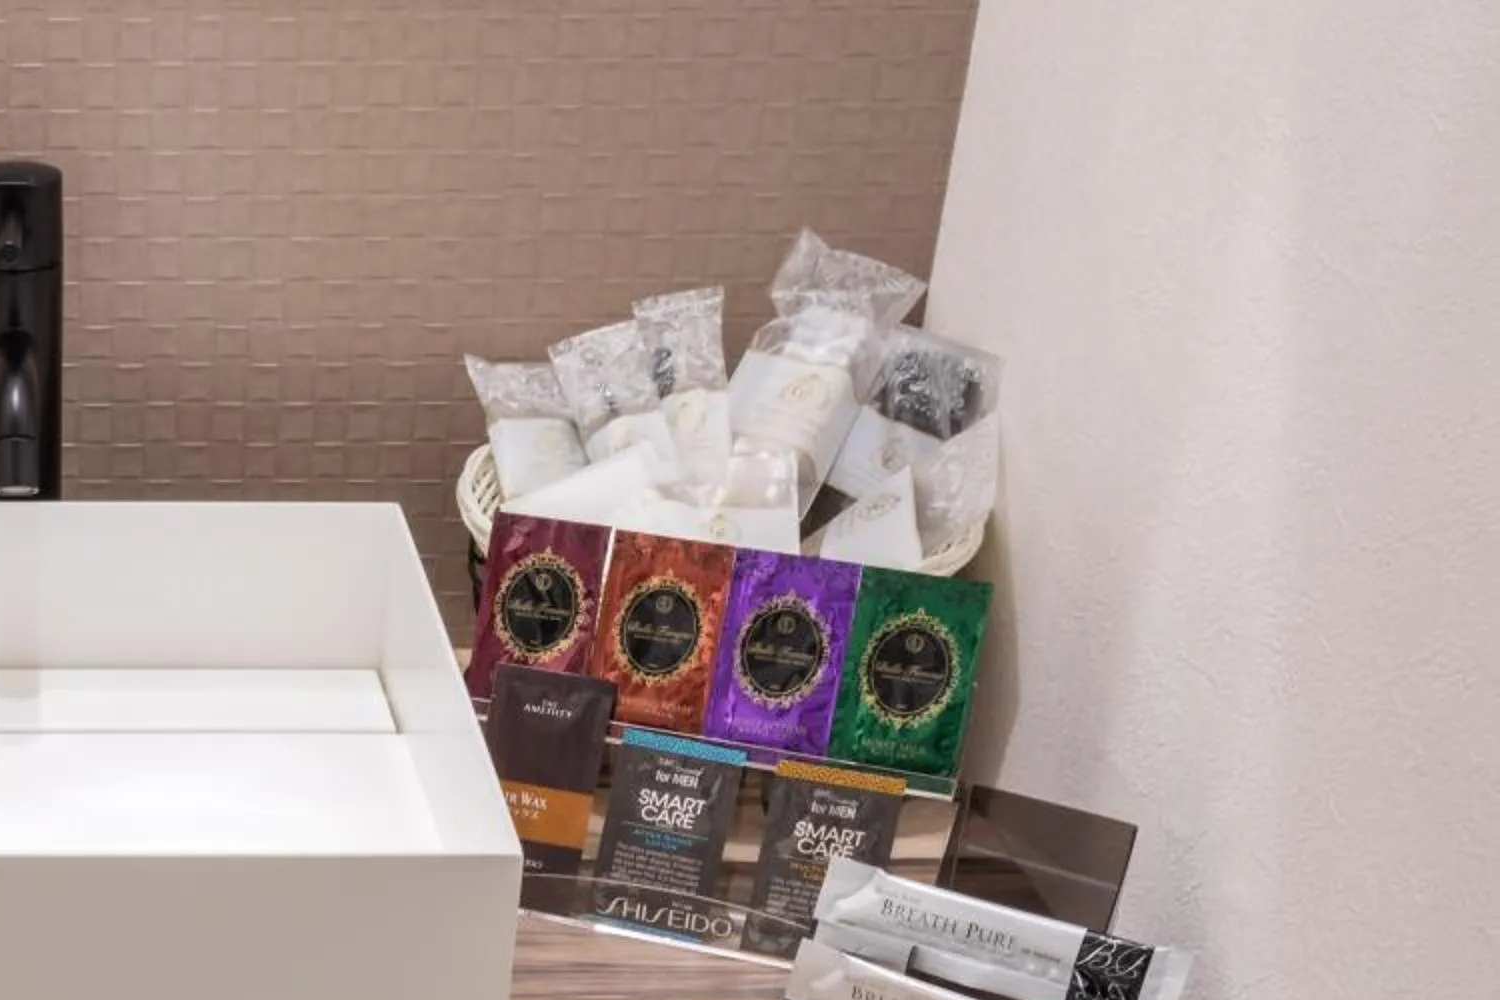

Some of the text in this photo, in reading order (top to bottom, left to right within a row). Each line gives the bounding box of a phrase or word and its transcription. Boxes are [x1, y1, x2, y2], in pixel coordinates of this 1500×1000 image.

[655, 770, 699, 789] for MEN
[521, 791, 548, 811] WAX
[637, 788, 707, 815] SMART
[828, 804, 857, 819] MEN
[641, 805, 697, 829] CARE
[794, 820, 867, 847] SMART
[797, 837, 855, 859] CARE
[596, 897, 733, 938] SHISEIDO
[880, 898, 1017, 950] BREATH PURE
